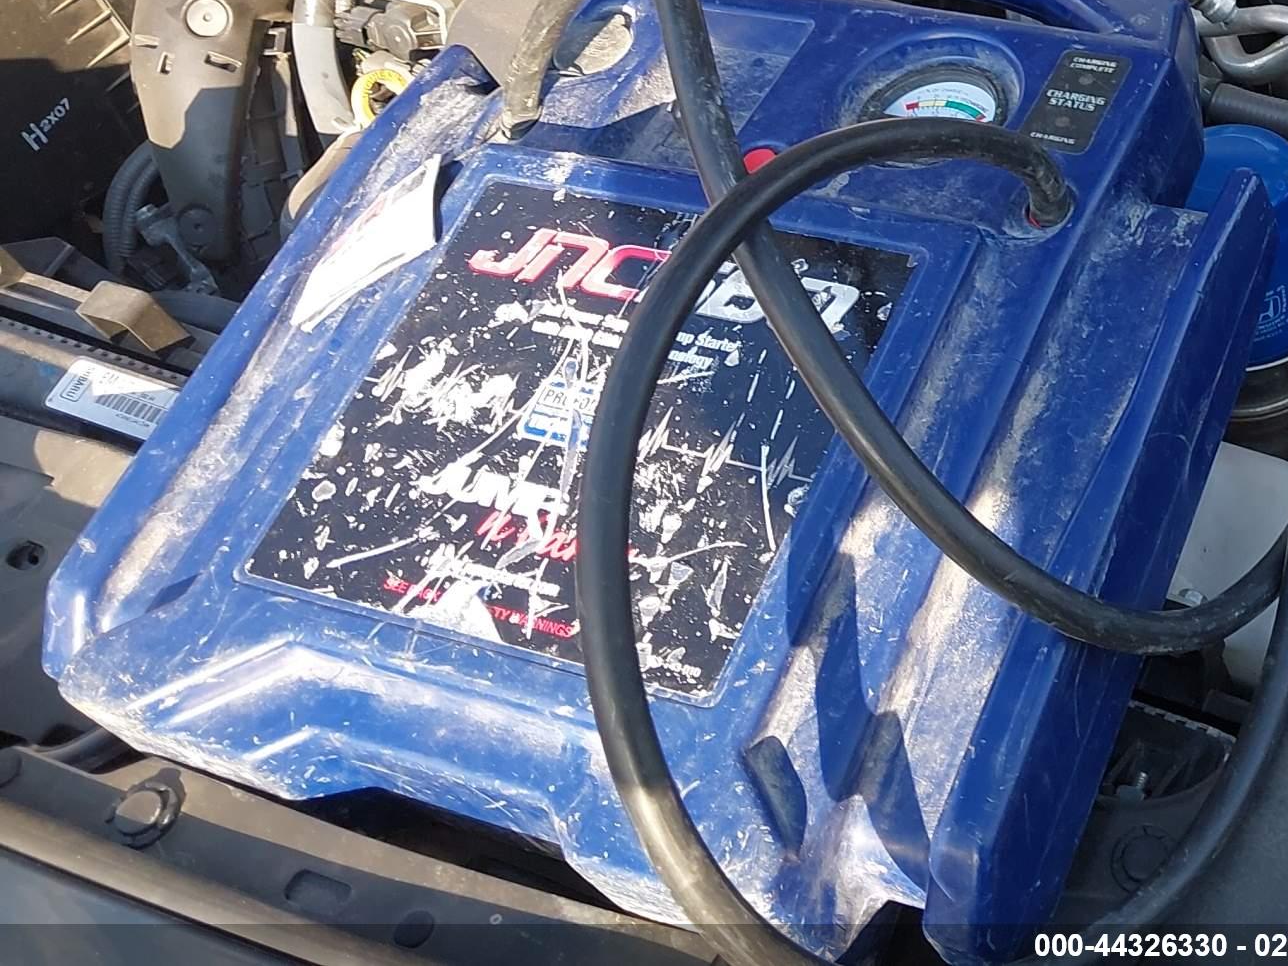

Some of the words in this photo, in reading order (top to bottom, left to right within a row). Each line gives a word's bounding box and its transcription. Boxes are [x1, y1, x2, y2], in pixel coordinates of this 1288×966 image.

[1070, 62, 1115, 73] COMPLETE
[1073, 56, 1118, 68] CHARGING
[1046, 89, 1107, 106] CHARGING
[1048, 97, 1096, 111] STATUS
[1030, 131, 1076, 144] CHARGING
